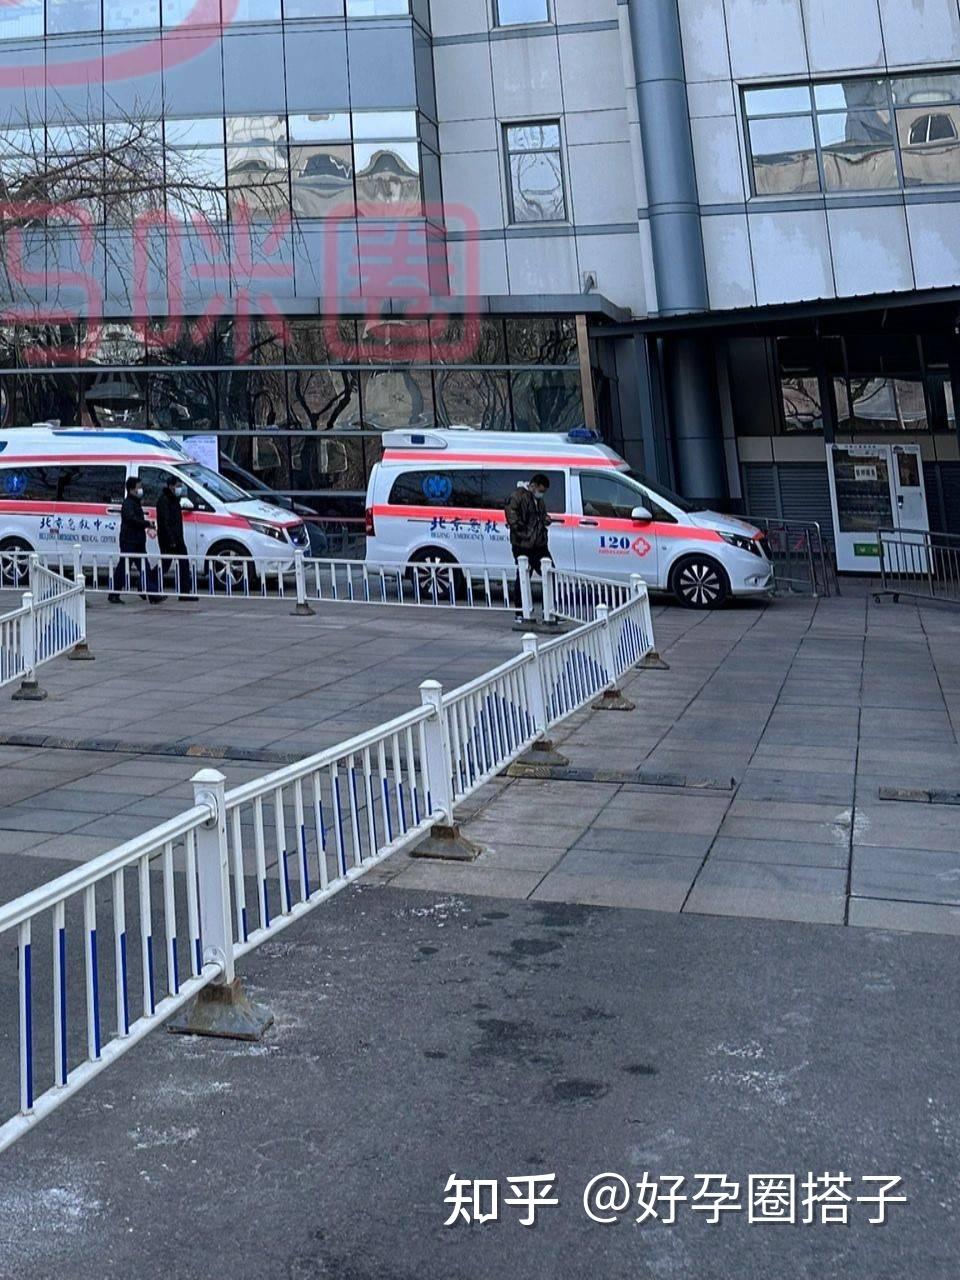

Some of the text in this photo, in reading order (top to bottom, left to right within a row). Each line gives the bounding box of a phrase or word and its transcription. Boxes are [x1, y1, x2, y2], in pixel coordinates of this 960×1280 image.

[40, 517, 116, 531] 北京急救中心
[430, 517, 510, 533] 北京急救
[600, 535, 630, 549] 120
